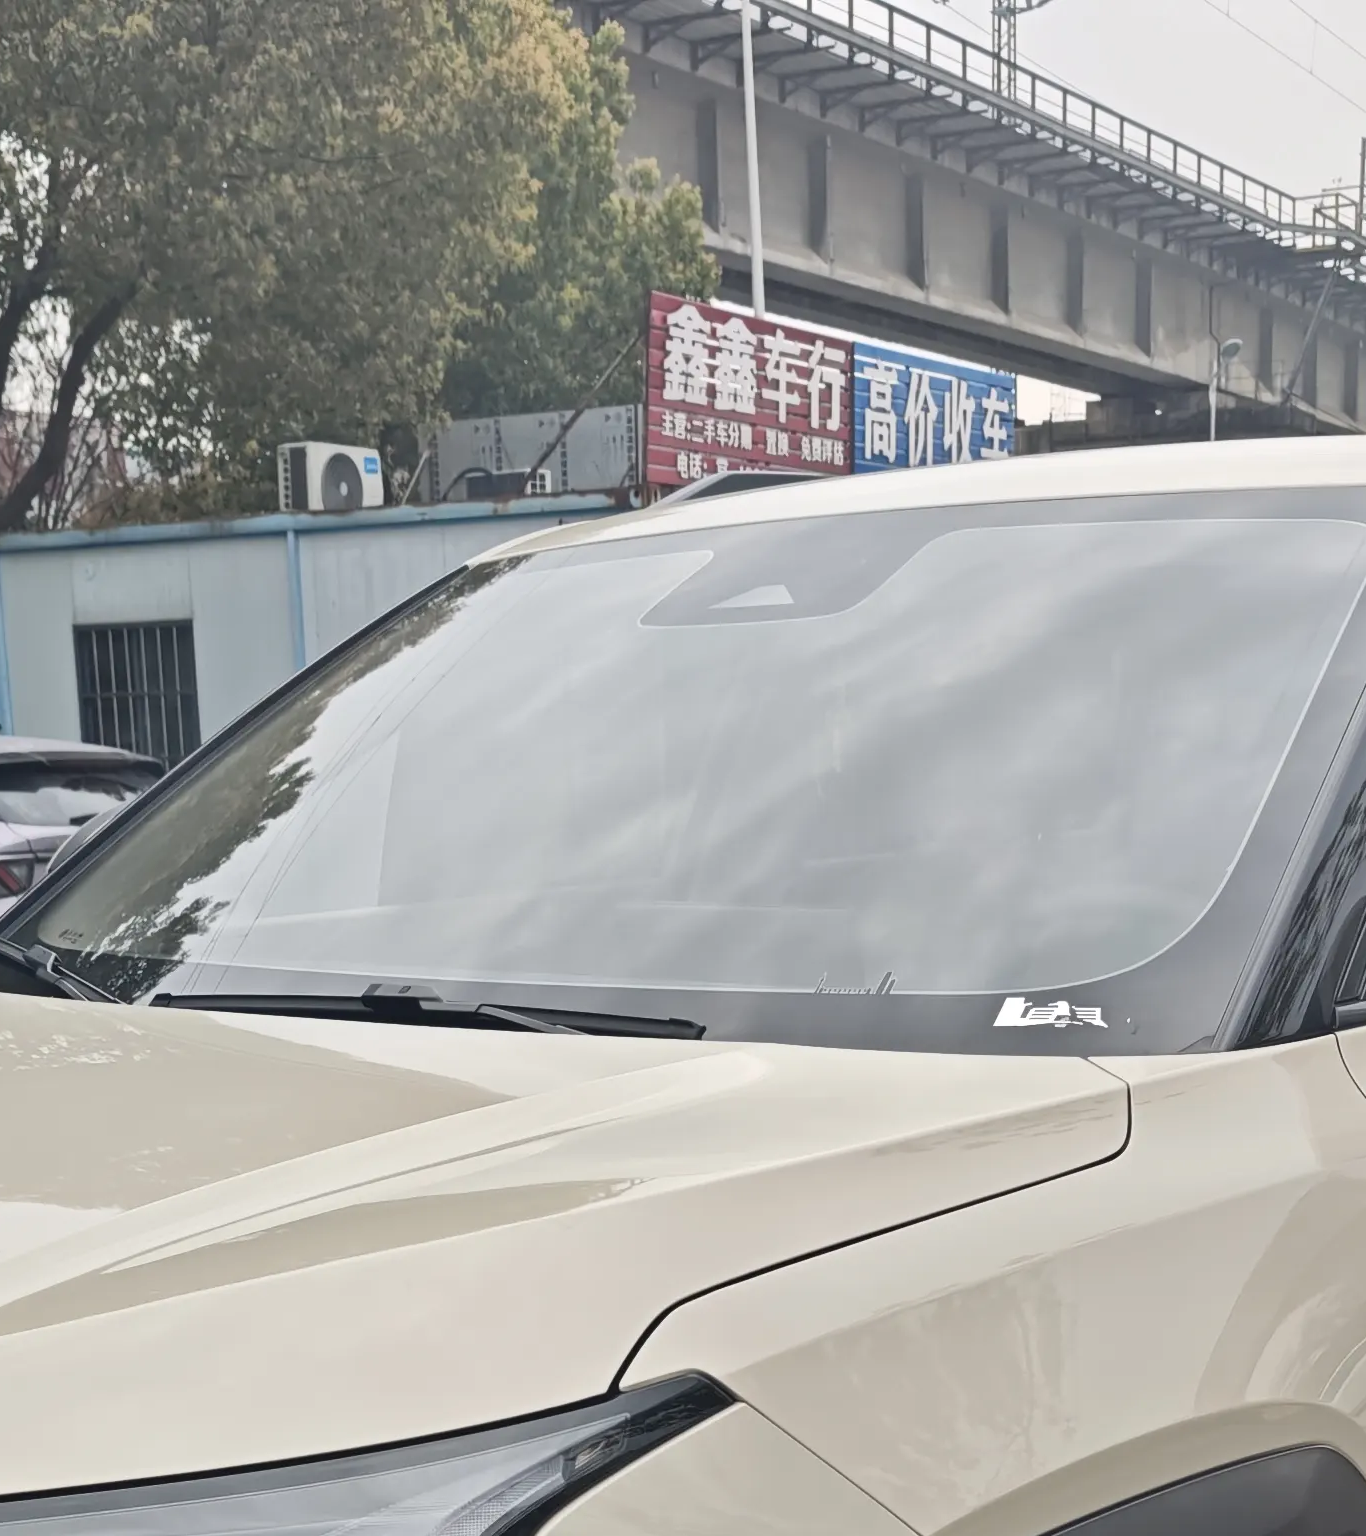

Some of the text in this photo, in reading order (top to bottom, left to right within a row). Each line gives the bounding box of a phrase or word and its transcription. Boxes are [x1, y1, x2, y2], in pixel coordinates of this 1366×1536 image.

[663, 305, 846, 431] 鑫鑫车行
[863, 360, 1009, 467] 高价收车
